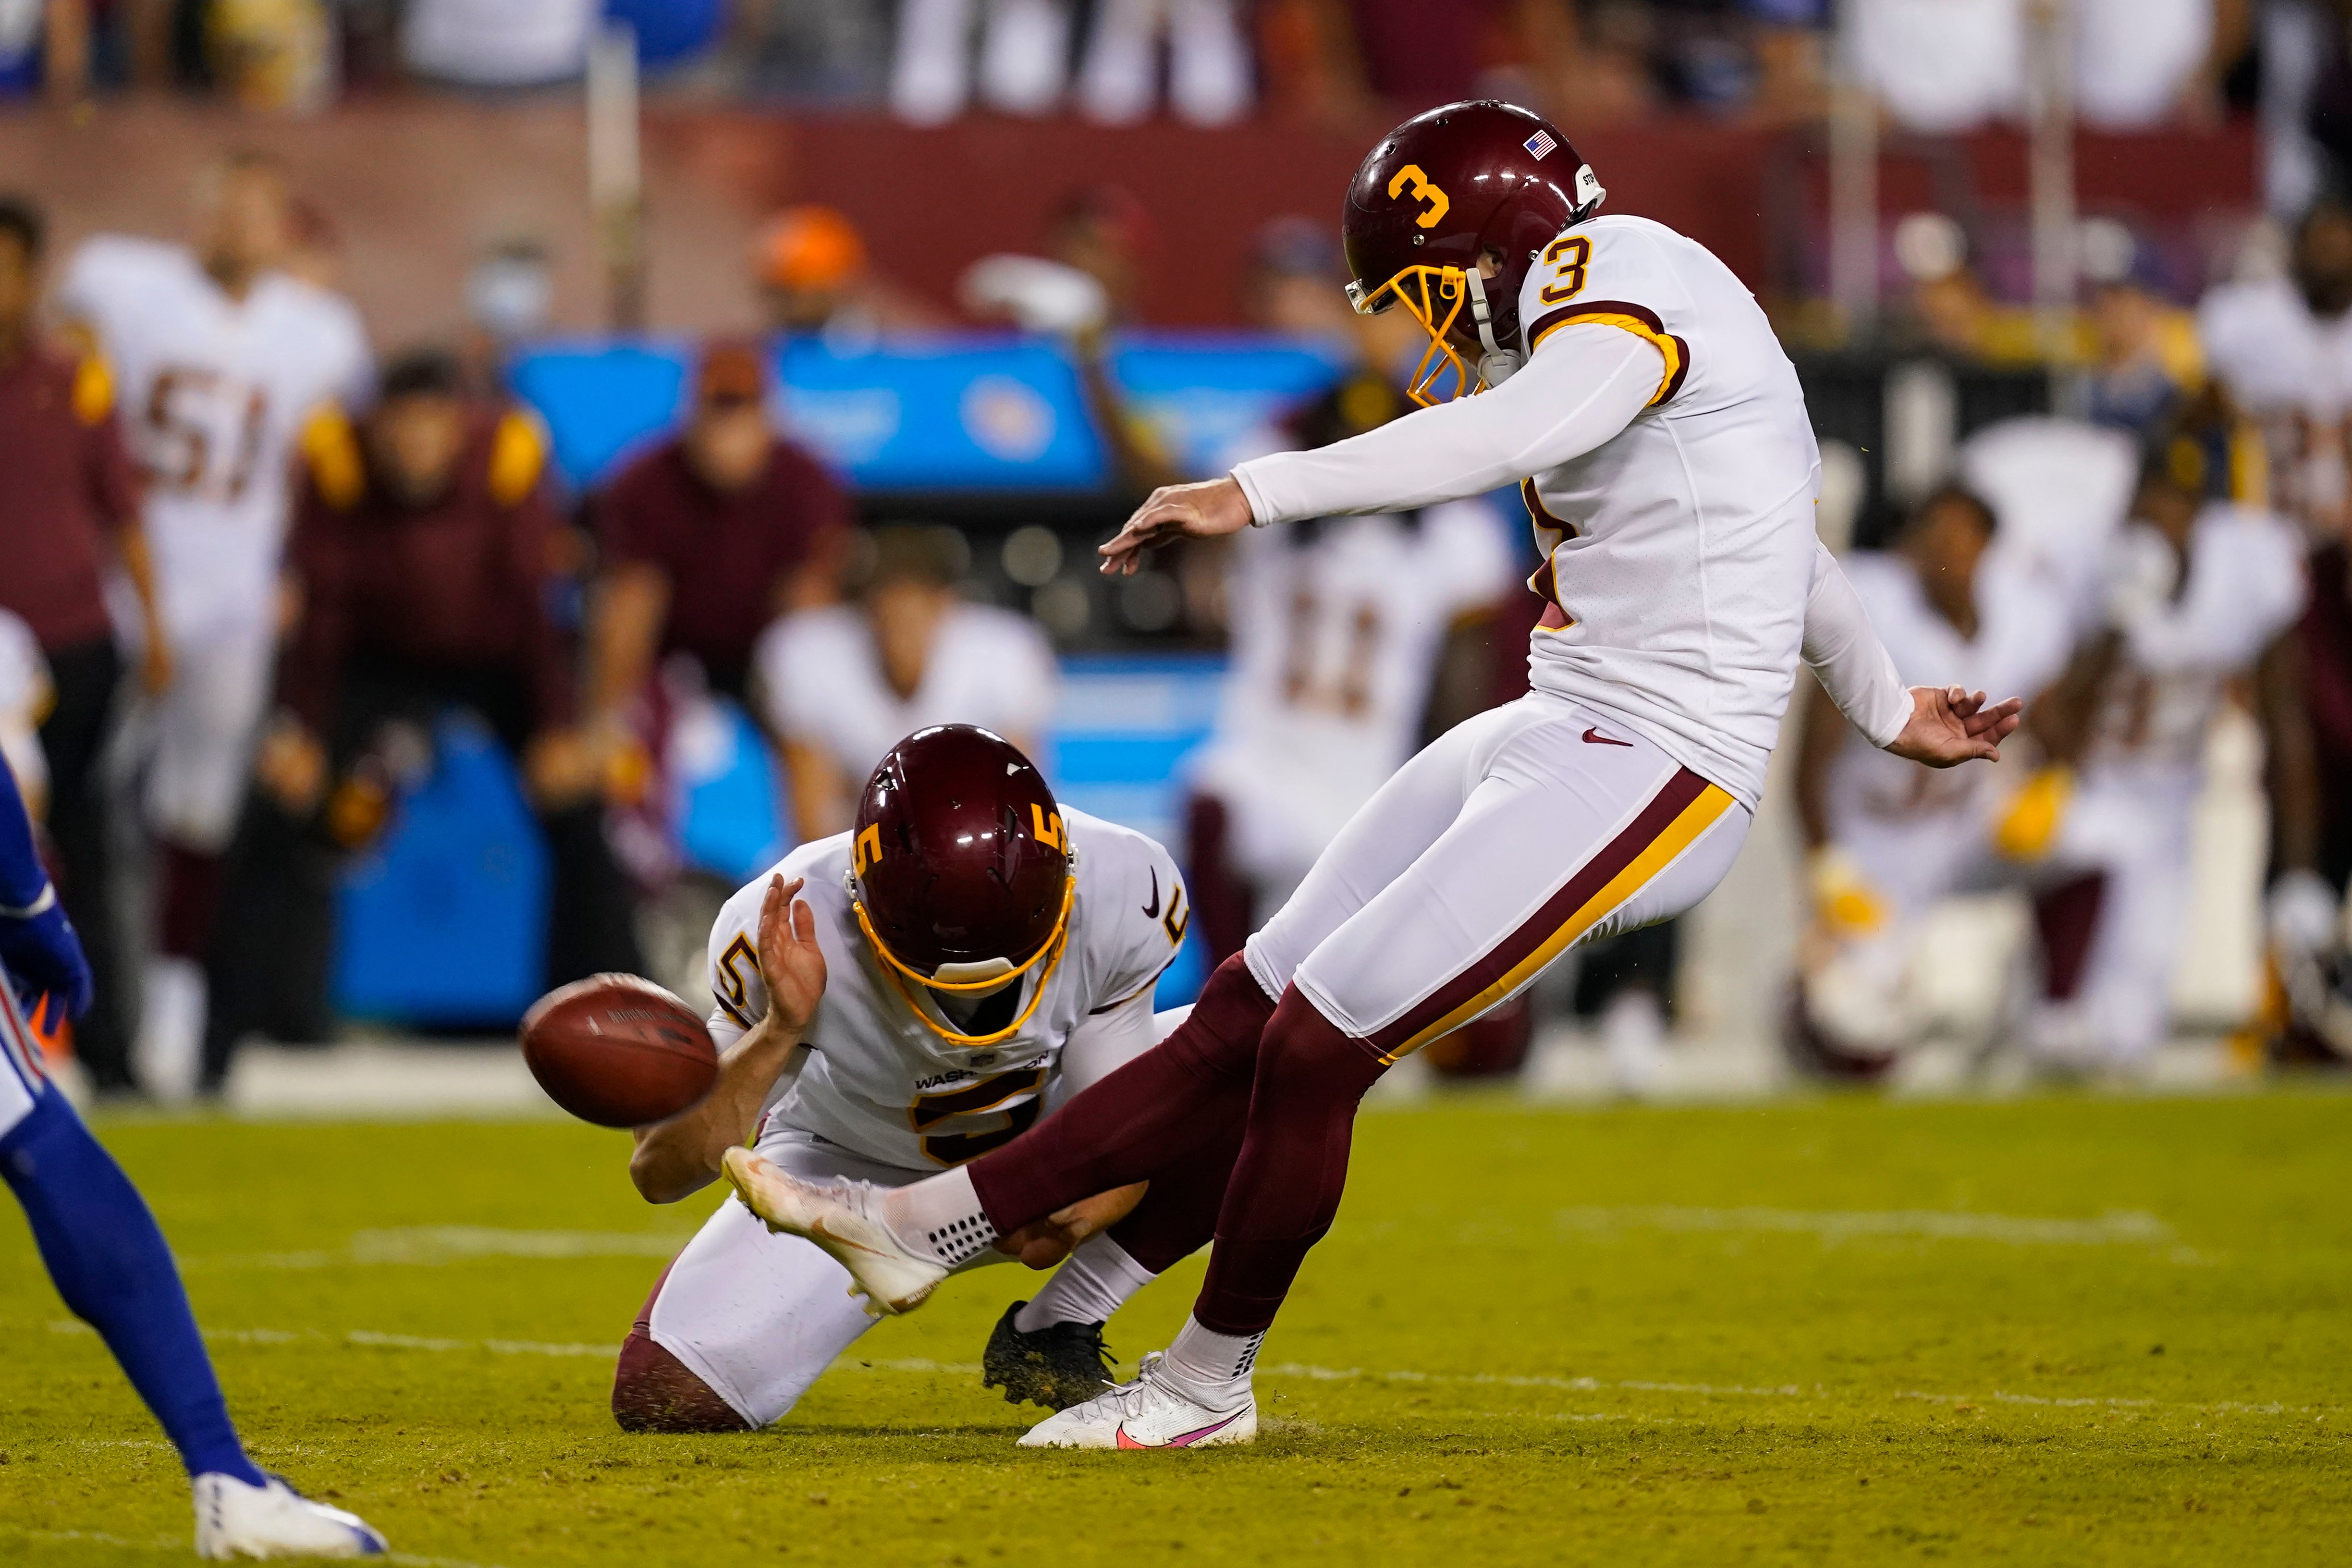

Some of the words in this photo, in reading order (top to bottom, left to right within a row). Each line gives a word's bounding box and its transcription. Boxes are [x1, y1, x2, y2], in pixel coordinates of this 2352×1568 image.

[1388, 165, 1449, 229] 3
[1540, 235, 1592, 306] 3
[138, 364, 270, 504] 51
[852, 822, 883, 881] 5
[1030, 803, 1067, 857] 5
[717, 931, 761, 1008] 5
[907, 1067, 1046, 1168] 5
